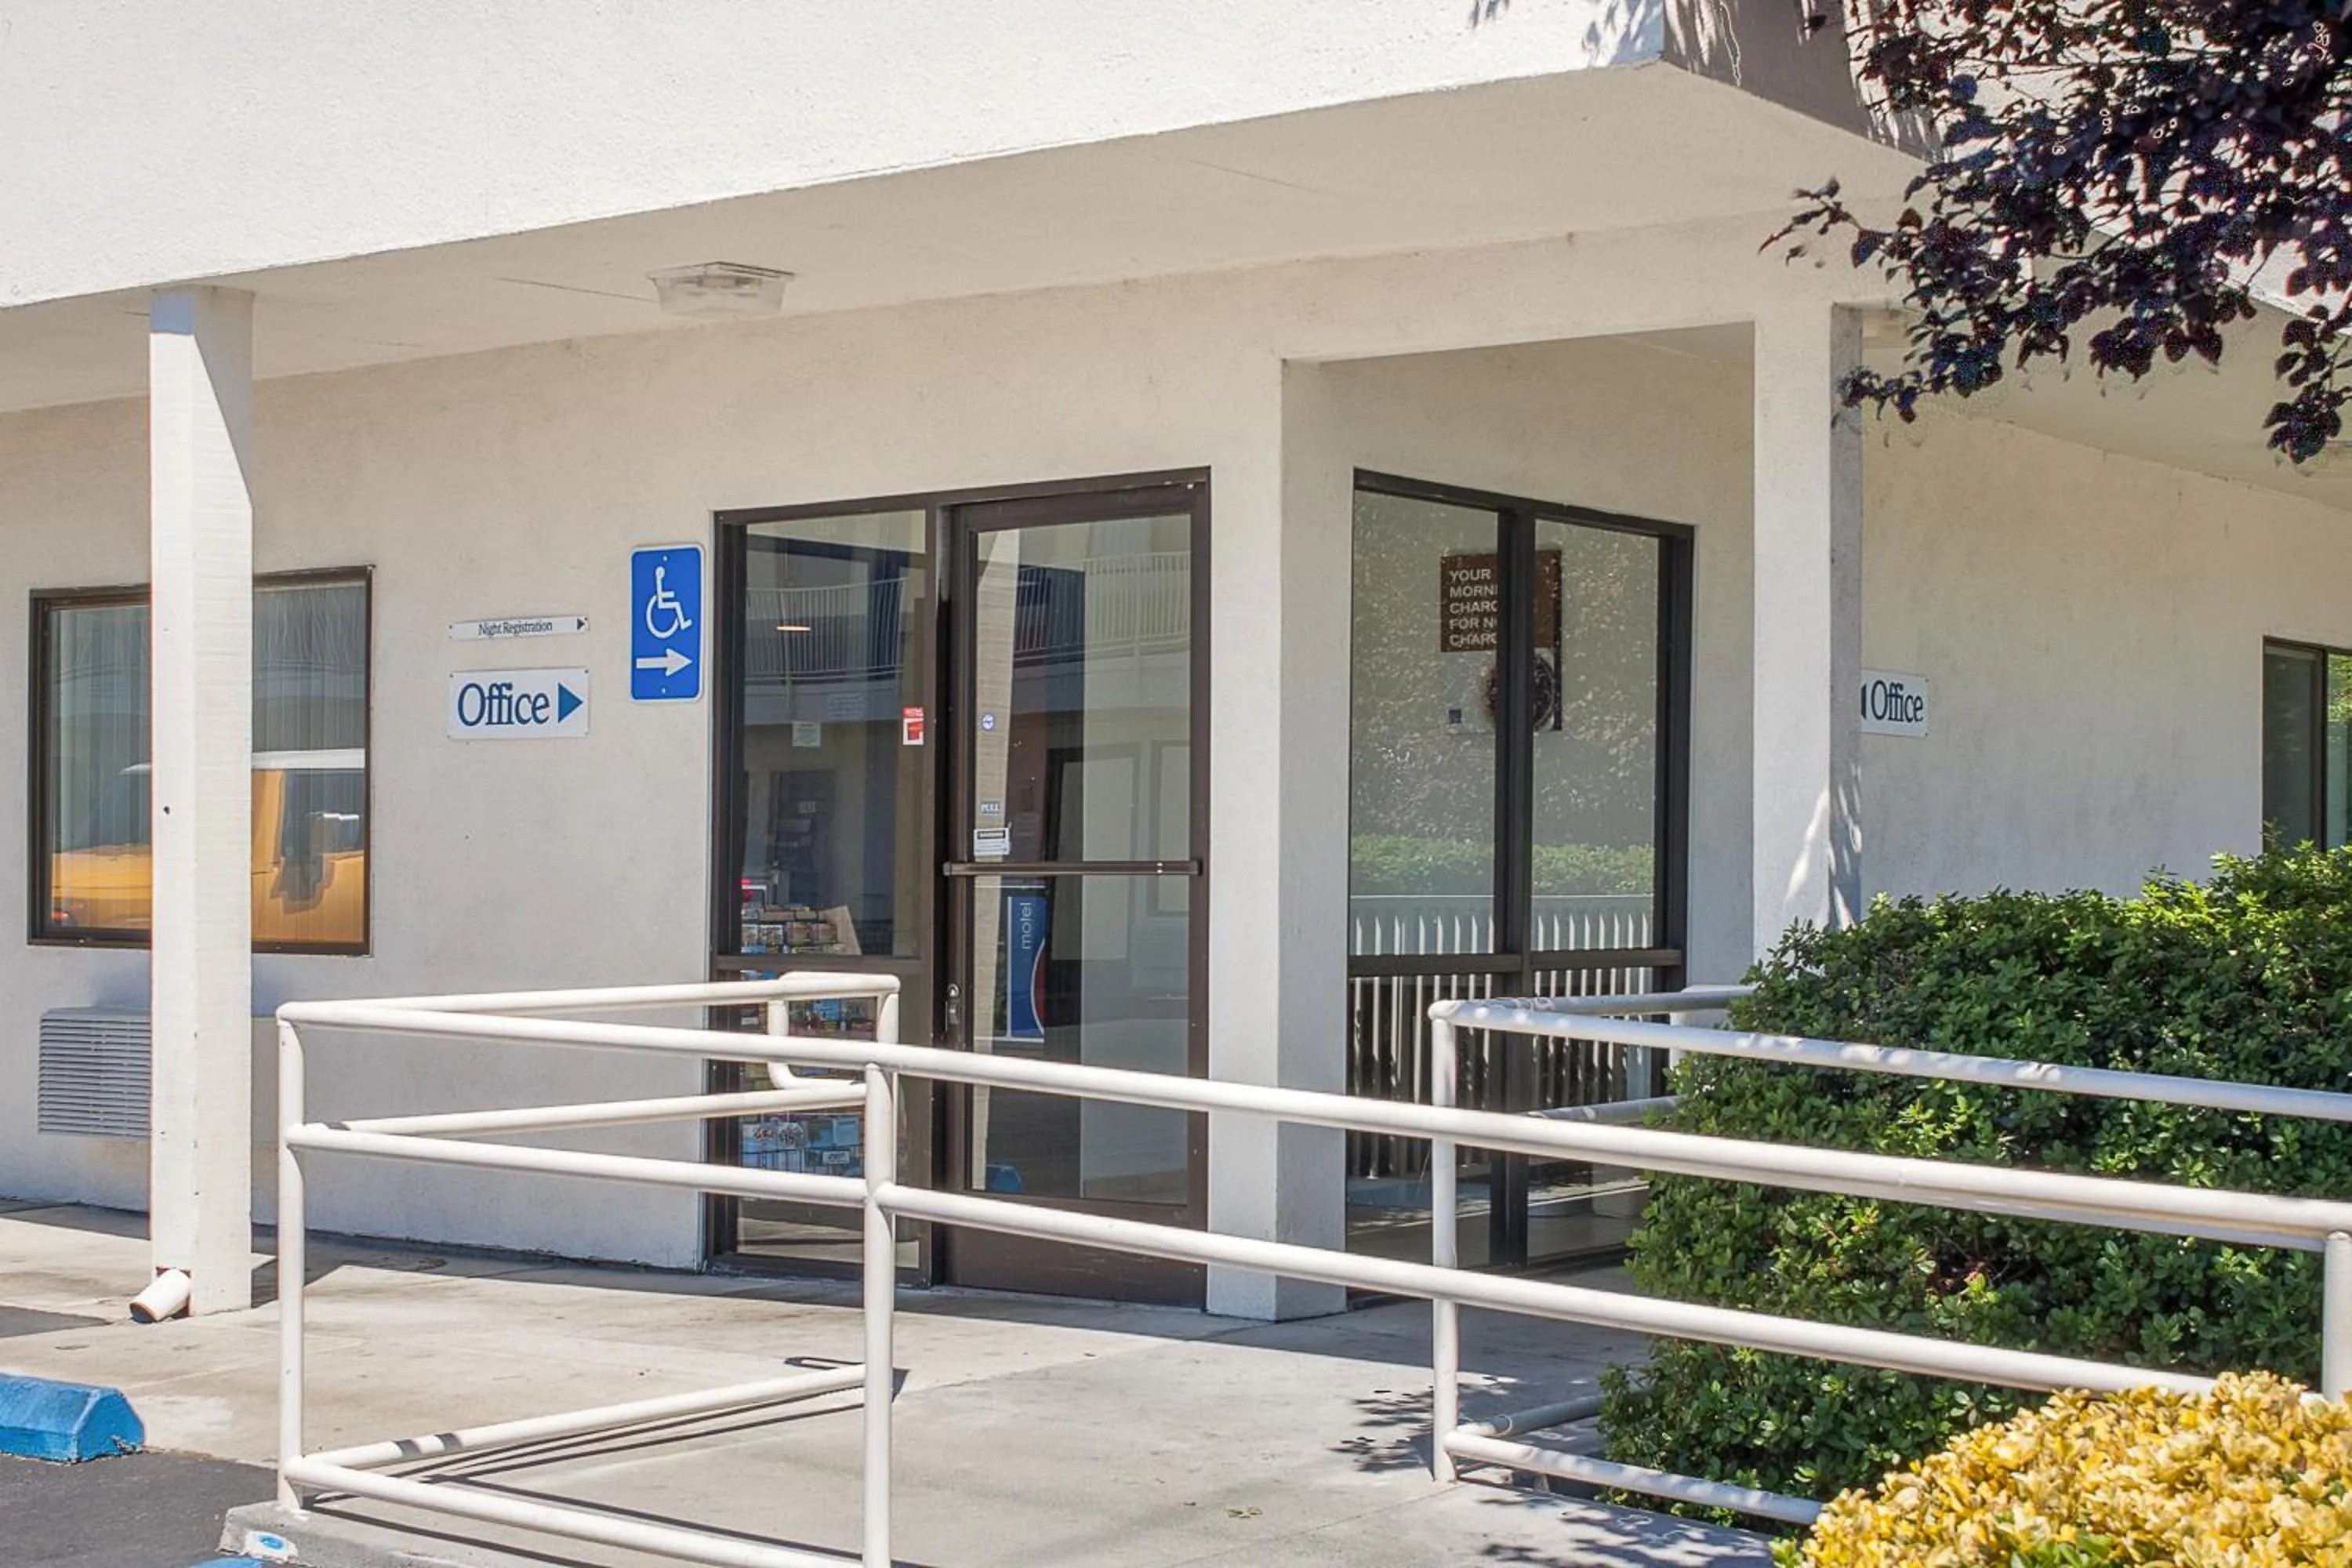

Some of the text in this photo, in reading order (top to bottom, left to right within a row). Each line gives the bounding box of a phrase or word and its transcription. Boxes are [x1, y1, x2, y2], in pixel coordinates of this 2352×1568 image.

[1449, 568, 1491, 583] YOUR
[477, 619, 553, 637] Night Registration
[1449, 616, 1498, 630] FOR N
[457, 681, 550, 727] Office
[1871, 680, 1923, 723] Office
[1019, 902, 1032, 949] motel
